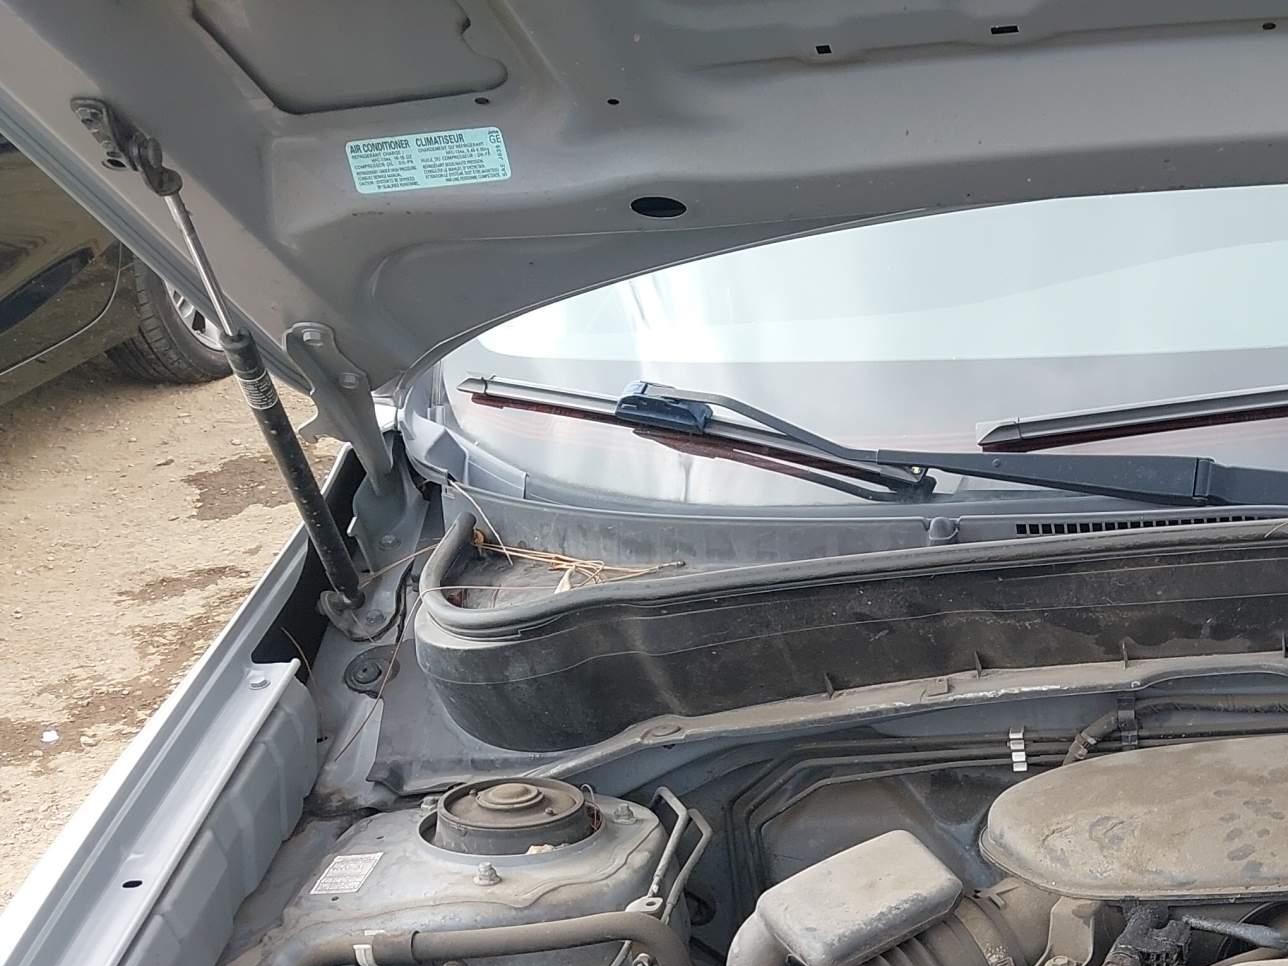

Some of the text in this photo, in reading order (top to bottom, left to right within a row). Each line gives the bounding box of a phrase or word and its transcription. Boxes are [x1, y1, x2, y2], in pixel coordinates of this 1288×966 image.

[415, 133, 465, 148] CLIMATISEUR
[489, 134, 501, 144] GE
[350, 140, 411, 154] AIR CONDITIONER
